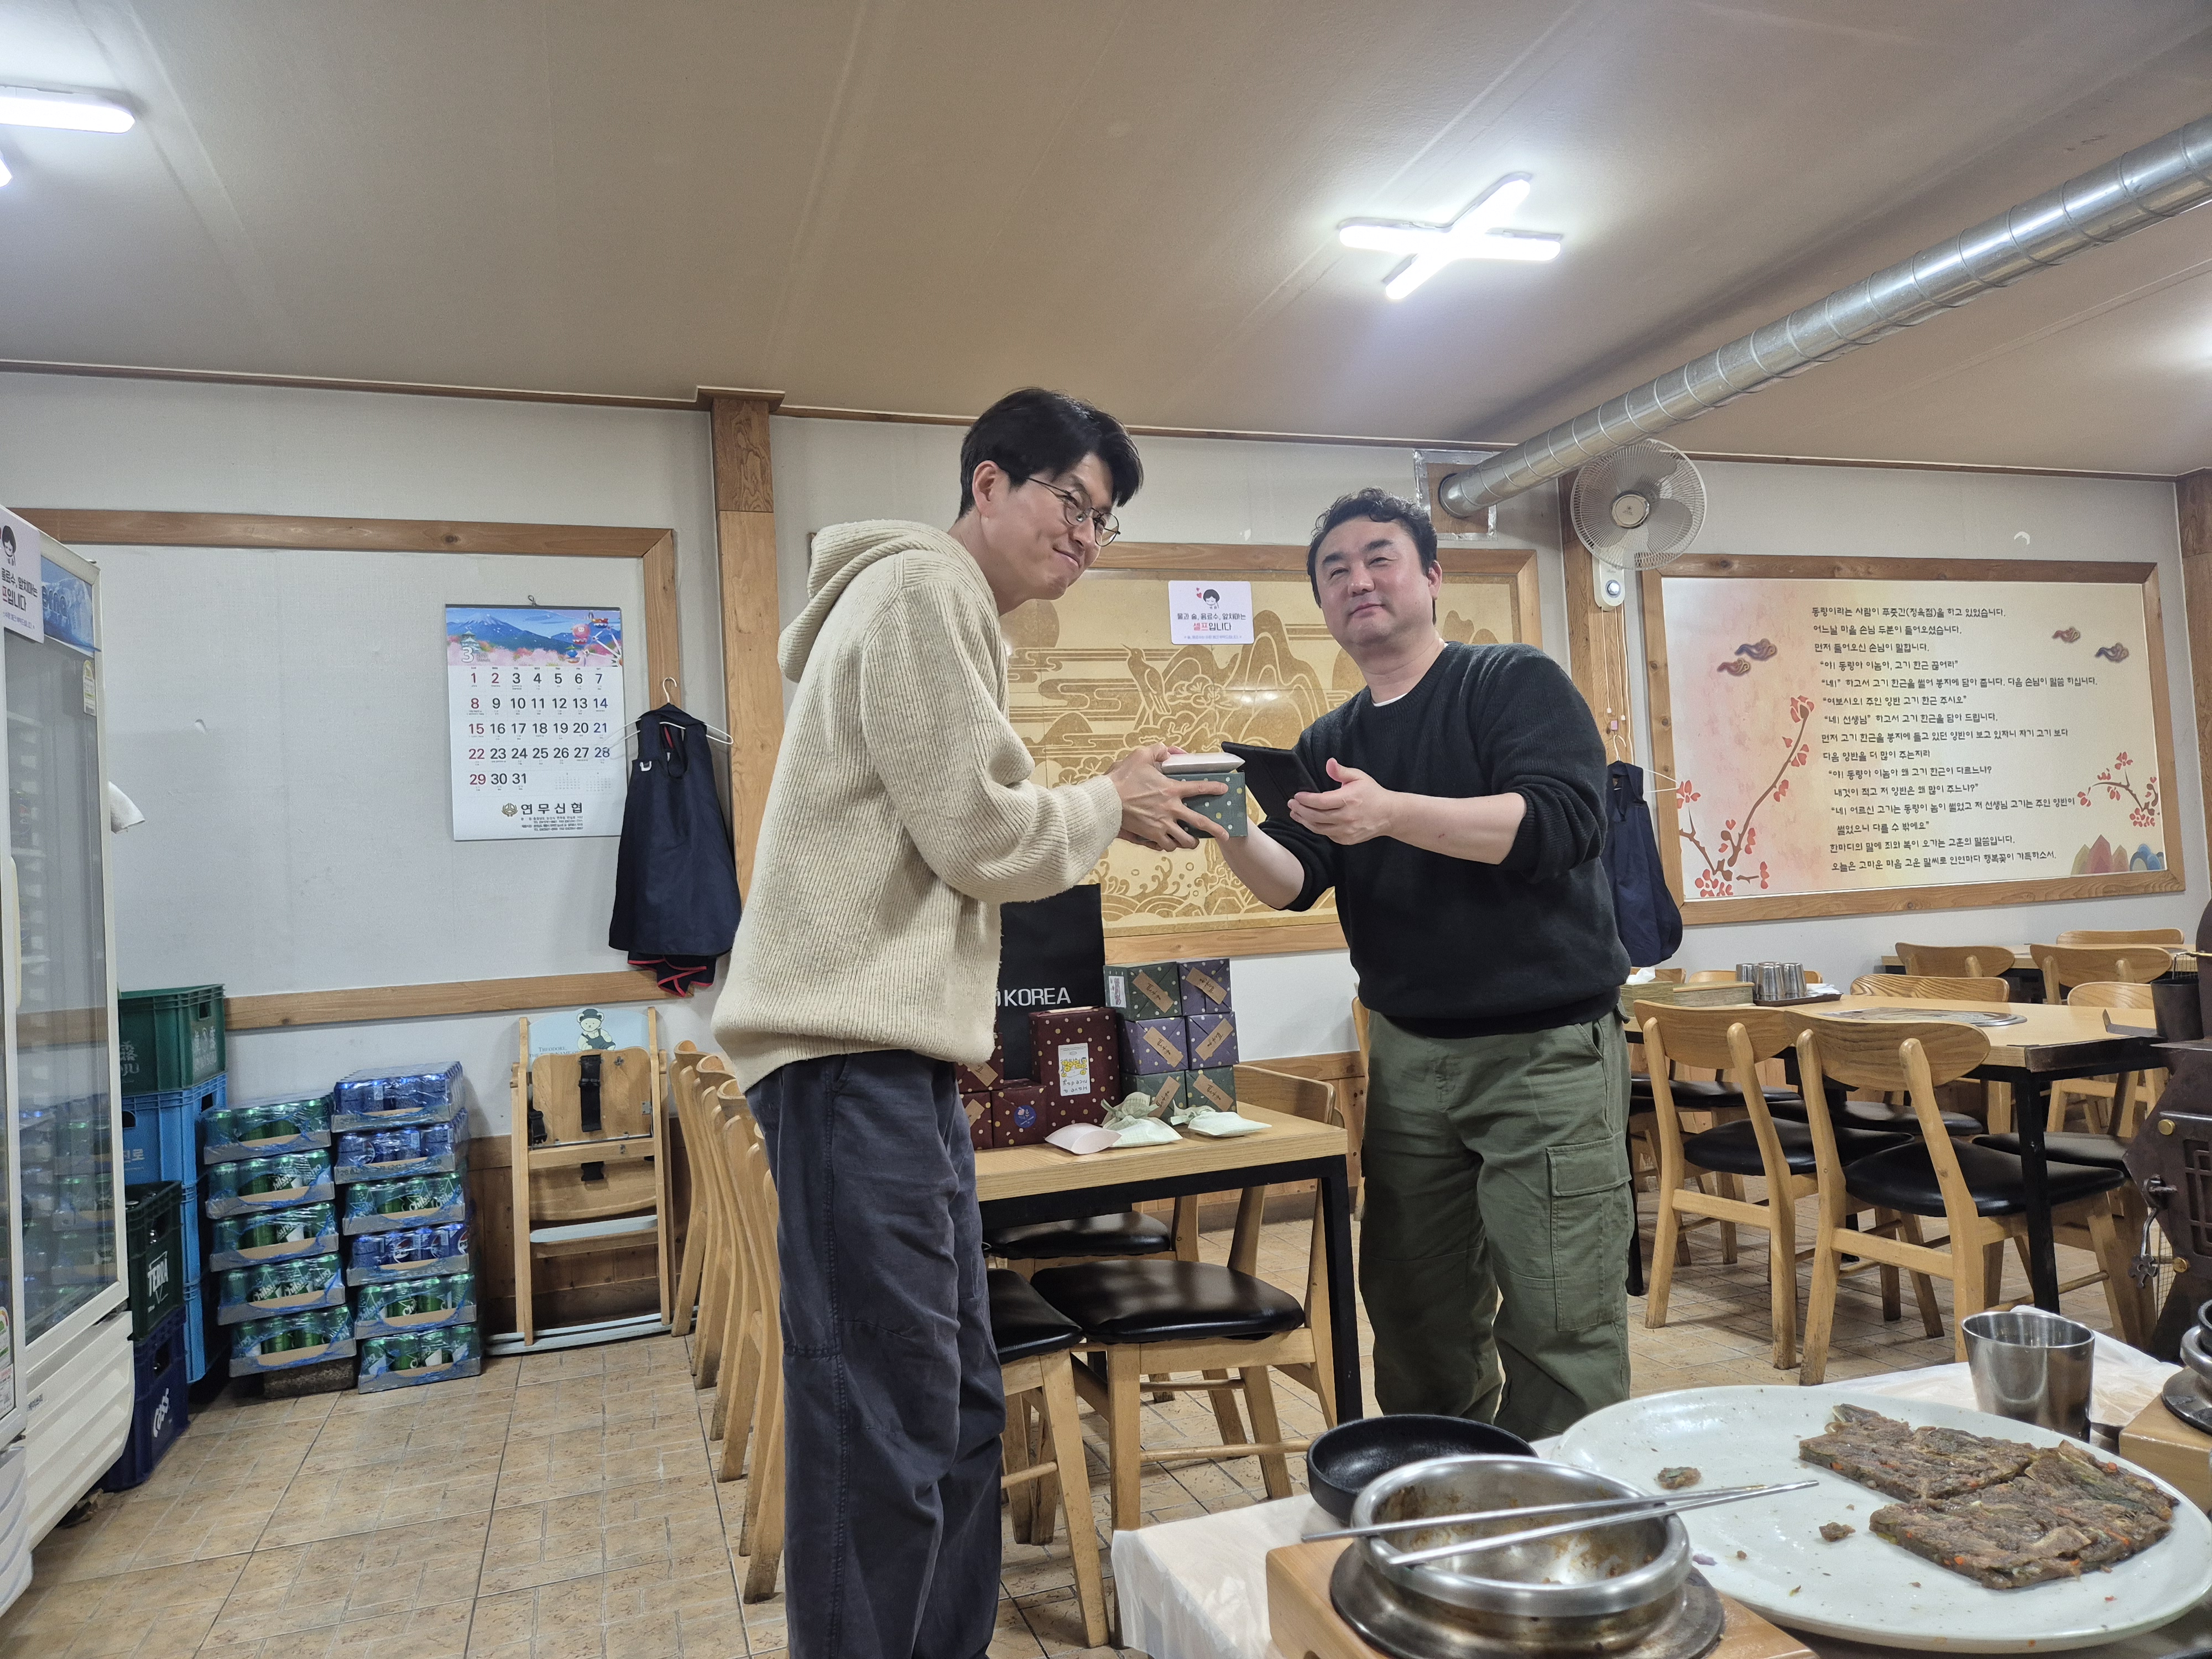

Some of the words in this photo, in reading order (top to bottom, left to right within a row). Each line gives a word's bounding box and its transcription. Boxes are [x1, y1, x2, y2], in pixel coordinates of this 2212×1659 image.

[18, 576, 38, 598] 앞치마는
[1855, 607, 1880, 617] 사람이
[1947, 608, 1963, 616] 하고
[1965, 608, 2006, 618] 있었습니다.
[1193, 622, 1232, 631] 셀프입니다
[1813, 624, 1838, 635] 어느날
[1840, 624, 1857, 636] 마을
[1859, 625, 1876, 635] 손님
[1877, 625, 1902, 635] 두분이
[1905, 625, 1962, 636] 들어오셨습니다.
[461, 646, 474, 663] 3
[1814, 643, 1831, 653] 먼저
[1833, 643, 1867, 654] 들어오신
[1869, 643, 1893, 653] 손님이
[1895, 643, 1929, 654] 말합니다.
[1866, 660, 1892, 671] 이놈아,
[1895, 660, 1911, 669] 고기
[1913, 660, 1929, 670] 한근
[471, 672, 476, 684] 1
[491, 672, 500, 684] 2
[512, 672, 521, 684] 3
[533, 672, 542, 684] 4
[554, 672, 563, 685] 5
[575, 672, 583, 685] 6
[594, 673, 603, 684] 7
[1845, 679, 1870, 687] 하고서
[1872, 679, 1889, 687] 고기
[1890, 678, 1916, 689] 한근을
[1917, 678, 1933, 689] 썰어
[1936, 678, 1959, 689] 봉지에
[1961, 677, 1978, 688] 담아
[1979, 677, 2006, 688] 줍니다.
[2007, 677, 2023, 687] 다음
[2025, 677, 2047, 687] 손님이
[2049, 677, 2064, 687] 말씀
[471, 697, 479, 709] 8
[492, 697, 501, 709] 9
[510, 697, 526, 709] 10
[531, 697, 545, 709] 11
[551, 697, 568, 709] 12
[572, 697, 588, 709] 13
[593, 697, 609, 709] 14
[1865, 696, 1882, 707] 주인
[1884, 696, 1901, 707] 양반
[1903, 696, 1919, 705] 고기
[1921, 696, 1938, 706] 한근
[1875, 714, 1900, 723] 하고서
[1902, 714, 1918, 723] 고기
[1919, 713, 1944, 724] 한근을
[1946, 713, 1962, 723] 담아
[1964, 712, 1998, 723] 드립니다.
[468, 723, 485, 735] 15
[489, 723, 506, 734] 16
[510, 723, 526, 734] 17
[532, 722, 548, 734] 18
[553, 722, 568, 734] 19
[572, 722, 589, 734] 20
[593, 722, 607, 733] 21
[1821, 733, 1838, 744] 먼저
[1840, 733, 1858, 742] 고기
[1859, 732, 1885, 743] 한근을
[1886, 732, 1911, 743] 봉지에
[1913, 732, 1929, 743] 들고
[1932, 731, 1948, 742] 있던
[1950, 730, 1974, 742] 양반이
[1975, 730, 1992, 739] 보고
[1994, 729, 2017, 740] 있자니
[2018, 729, 2034, 738] 자기
[2036, 728, 2052, 738] 고기
[2053, 728, 2068, 737] 보다
[468, 748, 486, 760] 22
[489, 748, 507, 760] 23
[511, 748, 528, 759] 24
[532, 747, 549, 759] 25
[553, 747, 570, 759] 26
[573, 747, 589, 759] 27
[594, 747, 611, 758] 28
[1822, 752, 1840, 763] 다음
[1841, 751, 1867, 762] 양반을
[1869, 750, 1877, 759] 더
[1880, 750, 1896, 761] 많이
[1898, 749, 1931, 760] 주는지라
[469, 773, 487, 785] 29
[490, 773, 508, 785] 30
[512, 773, 526, 785] 31
[1874, 768, 1898, 779] 이놈아
[1901, 768, 1909, 776] 왜
[1911, 767, 1928, 776] 고기
[1929, 766, 1954, 777] 한근이
[1834, 787, 1859, 799] 내것이
[1861, 787, 1878, 797] 적고
[1880, 786, 1888, 795] 저
[1891, 785, 1916, 797] 양반은
[1917, 785, 1926, 794] 왜
[1928, 784, 1944, 795] 많이
[521, 802, 583, 815] 연무신협
[1850, 805, 1875, 815] 어르신
[1877, 804, 1901, 815] 고기는
[1930, 802, 1947, 813] 놈이
[1948, 802, 1973, 813] 썰었고
[1974, 801, 1983, 810] 저
[1985, 800, 2008, 811] 선생님
[2010, 799, 2033, 809] 고기는
[2035, 798, 2051, 808] 주인
[2053, 797, 2075, 808] 양반이
[1837, 823, 1870, 836] 썰었으니
[1872, 823, 1889, 834] 다를
[1891, 822, 1900, 832] 수
[1829, 842, 1863, 854] 한마디의
[1865, 841, 1882, 853] 말에
[1903, 839, 1919, 851] 복이
[1922, 838, 1946, 848] 오가는
[1974, 835, 2015, 847] 말씀입니다.
[1831, 861, 1856, 873] 오늘은
[1858, 859, 1884, 870] 고마운
[1886, 858, 1902, 869] 마음
[1905, 858, 1921, 868] 고운
[1923, 856, 1948, 868] 말씨로
[1949, 854, 1981, 865] 인연마다
[1983, 852, 2014, 864] 행복꽃이
[2016, 850, 2057, 862] 가득하소서.
[1004, 987, 1072, 1007] KOREA
[1062, 1079, 1074, 1087] day
[147, 1258, 169, 1297] TERRA
